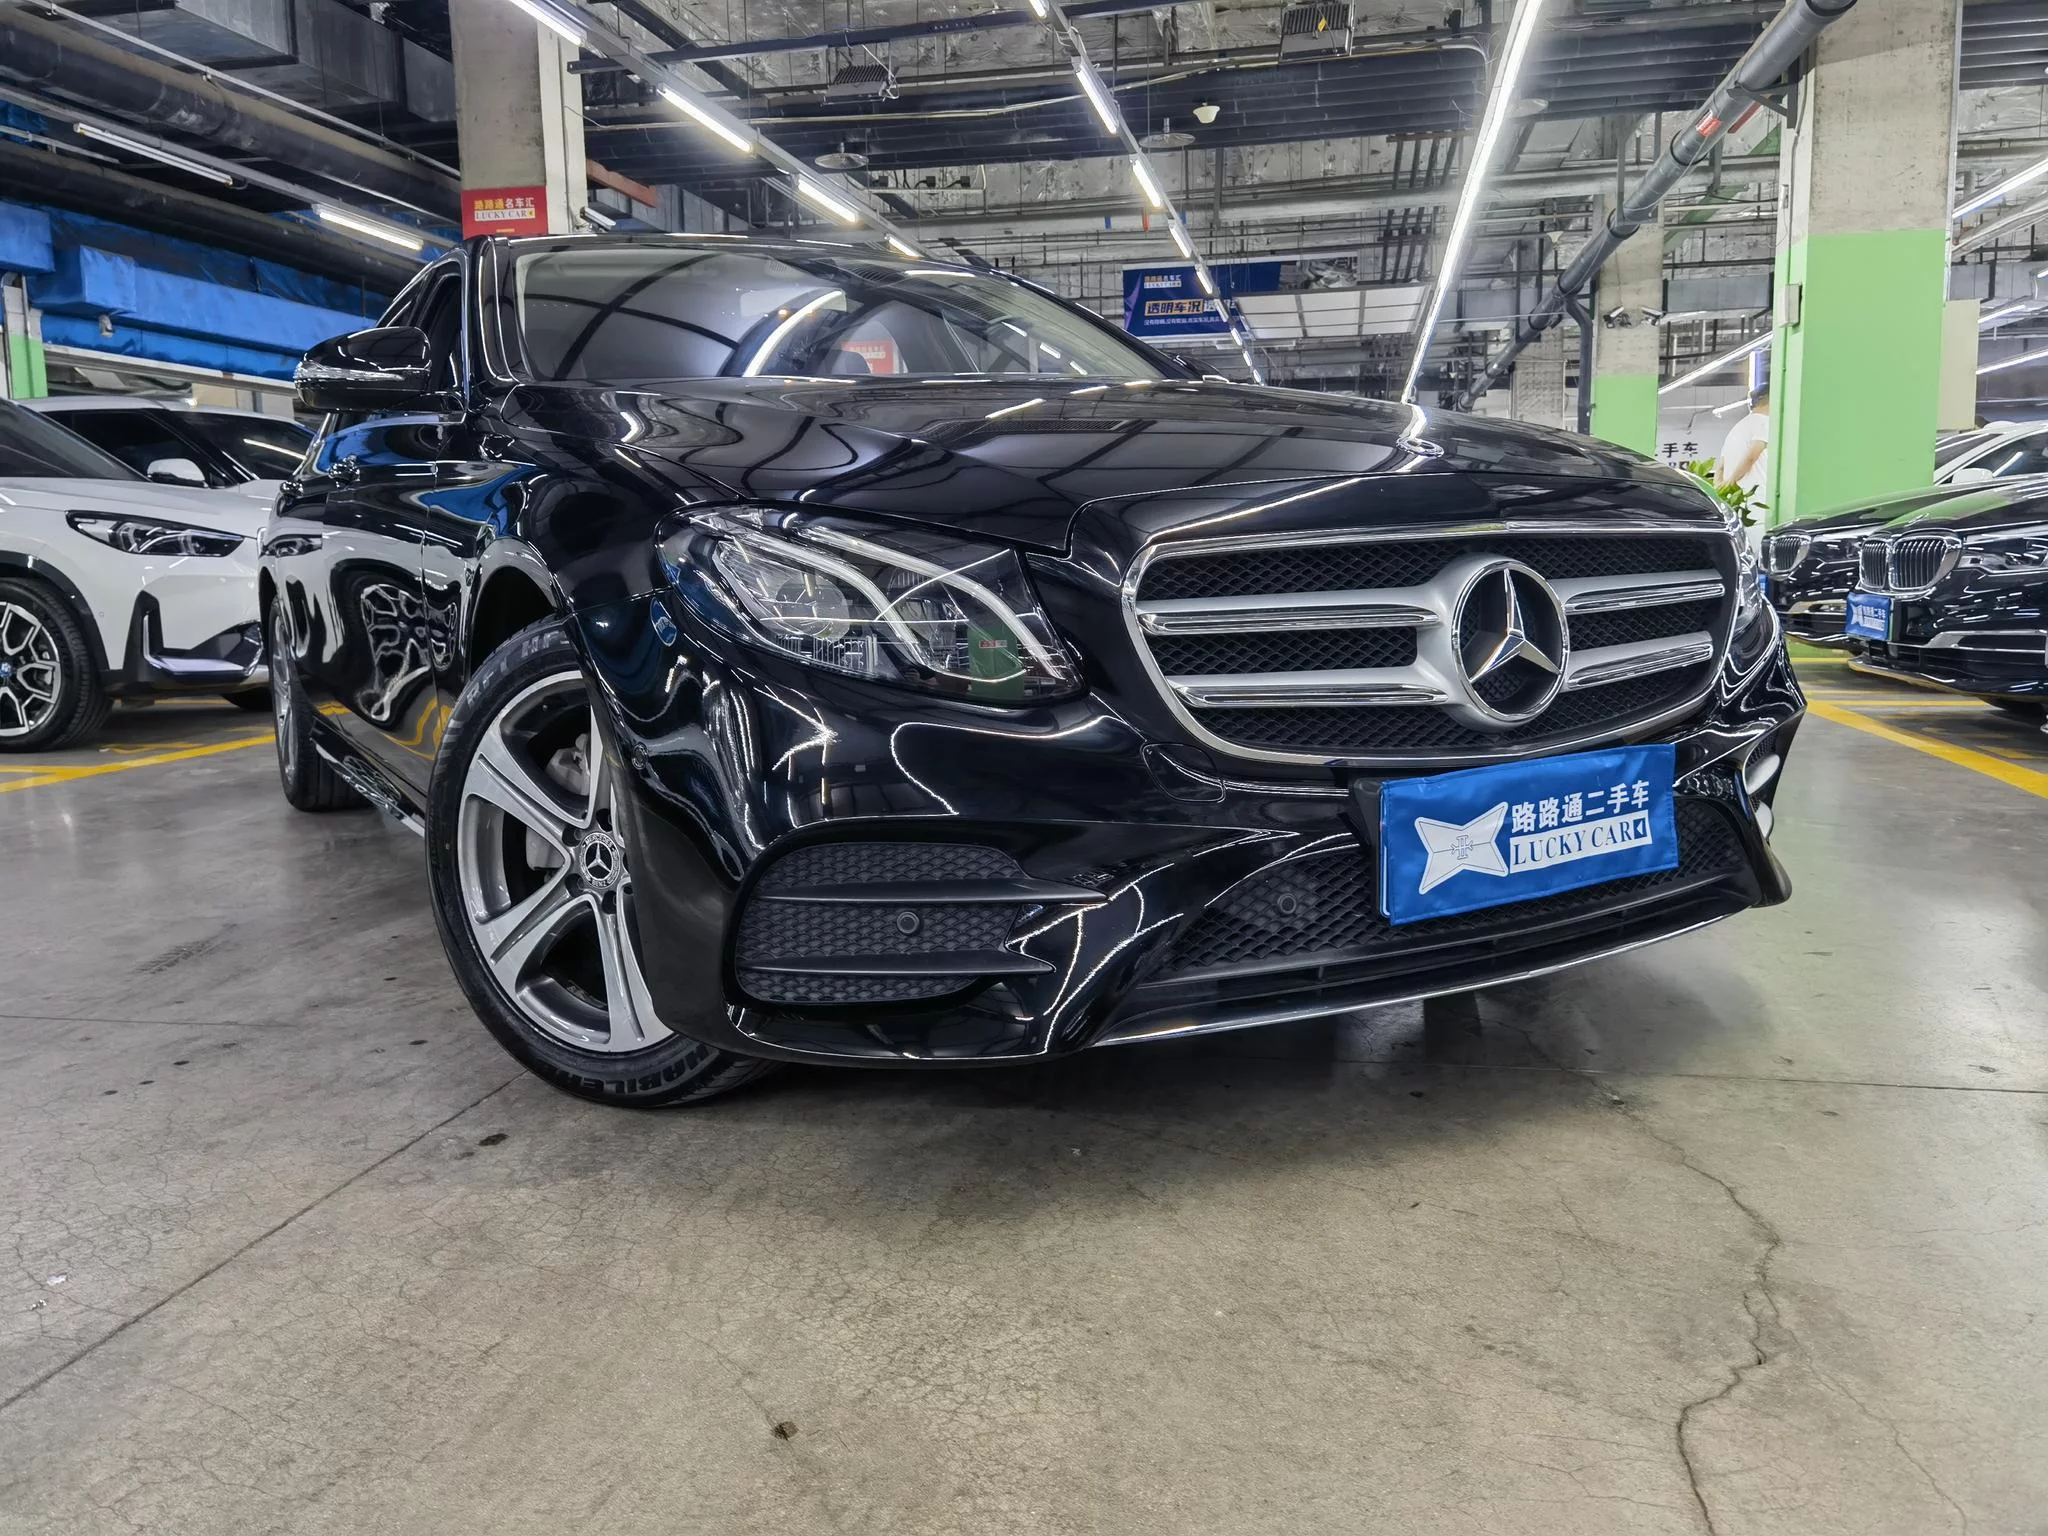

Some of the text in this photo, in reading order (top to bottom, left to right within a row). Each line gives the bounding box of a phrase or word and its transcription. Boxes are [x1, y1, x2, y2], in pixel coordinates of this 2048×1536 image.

[476, 210, 527, 220] LUCKY CAR
[1147, 301, 1201, 314] 透明车况
[1655, 442, 1698, 458] 手车
[1511, 780, 1650, 834] 路路通二手车
[1514, 820, 1633, 866] LUCKY CAR
